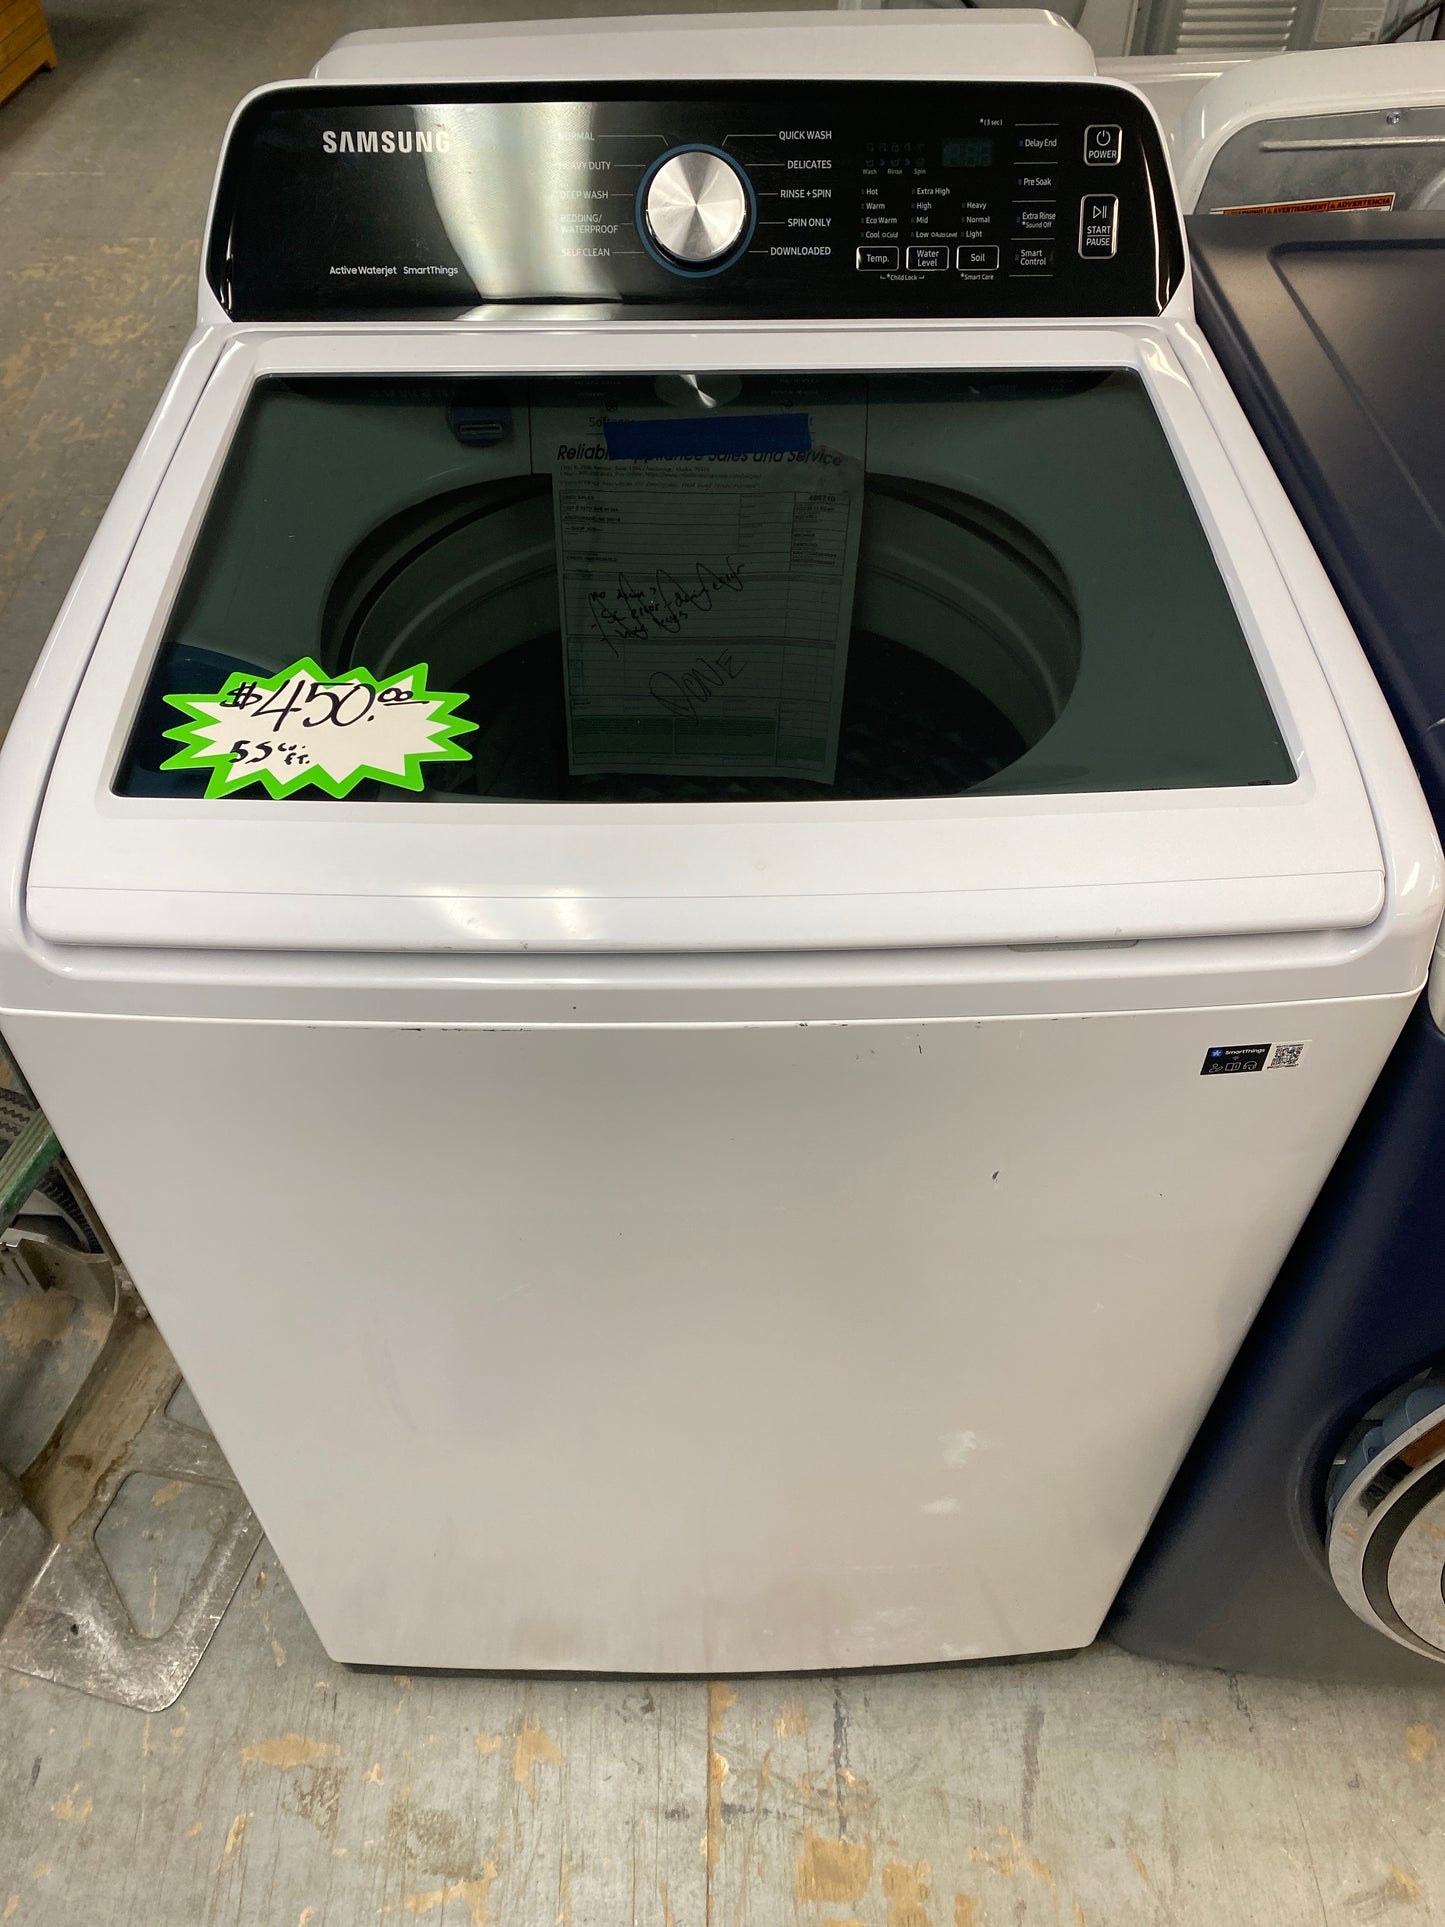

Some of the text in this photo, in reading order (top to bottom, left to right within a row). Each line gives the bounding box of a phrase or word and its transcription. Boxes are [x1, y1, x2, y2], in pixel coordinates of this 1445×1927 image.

[779, 130, 832, 141] QUICK WASH
[322, 130, 450, 154] SAMSUNG
[1025, 138, 1057, 148] Delay End
[1088, 150, 1117, 159] POWER
[589, 160, 611, 170] DUTY
[787, 160, 832, 169] DELICATES
[914, 168, 927, 176] Spin
[1023, 177, 1052, 186] Pre Soak
[560, 190, 609, 200] DEEP WASH
[780, 189, 805, 198] RINSE
[812, 189, 832, 198] SPIN
[935, 187, 951, 196] High
[865, 202, 886, 210] Warm
[916, 202, 932, 210] High
[966, 202, 987, 210] Heavy
[1337, 198, 1391, 208] ADVERTENCIA
[916, 216, 929, 224] Mid
[966, 215, 991, 224] Normal
[1022, 211, 1056, 220] Extra Rinse
[787, 218, 832, 228] SPIN ONLY
[865, 216, 898, 225] Eco Warm
[966, 230, 983, 239] Light
[1087, 225, 1111, 235] START
[865, 231, 880, 239] Cool
[915, 231, 930, 239] Low
[1086, 237, 1110, 246] PAUSE
[561, 247, 611, 257] SELF CLEAN
[770, 246, 832, 256] DOWNLOADED
[916, 249, 940, 258] Water
[1020, 249, 1043, 257] Smart
[866, 253, 890, 264] Temp.
[970, 253, 986, 262] Soil
[1020, 257, 1047, 266] Control
[917, 258, 938, 267] Level
[329, 265, 459, 277] Active Waterjet SmartThings
[1225, 1048, 1266, 1056] SmartThings
